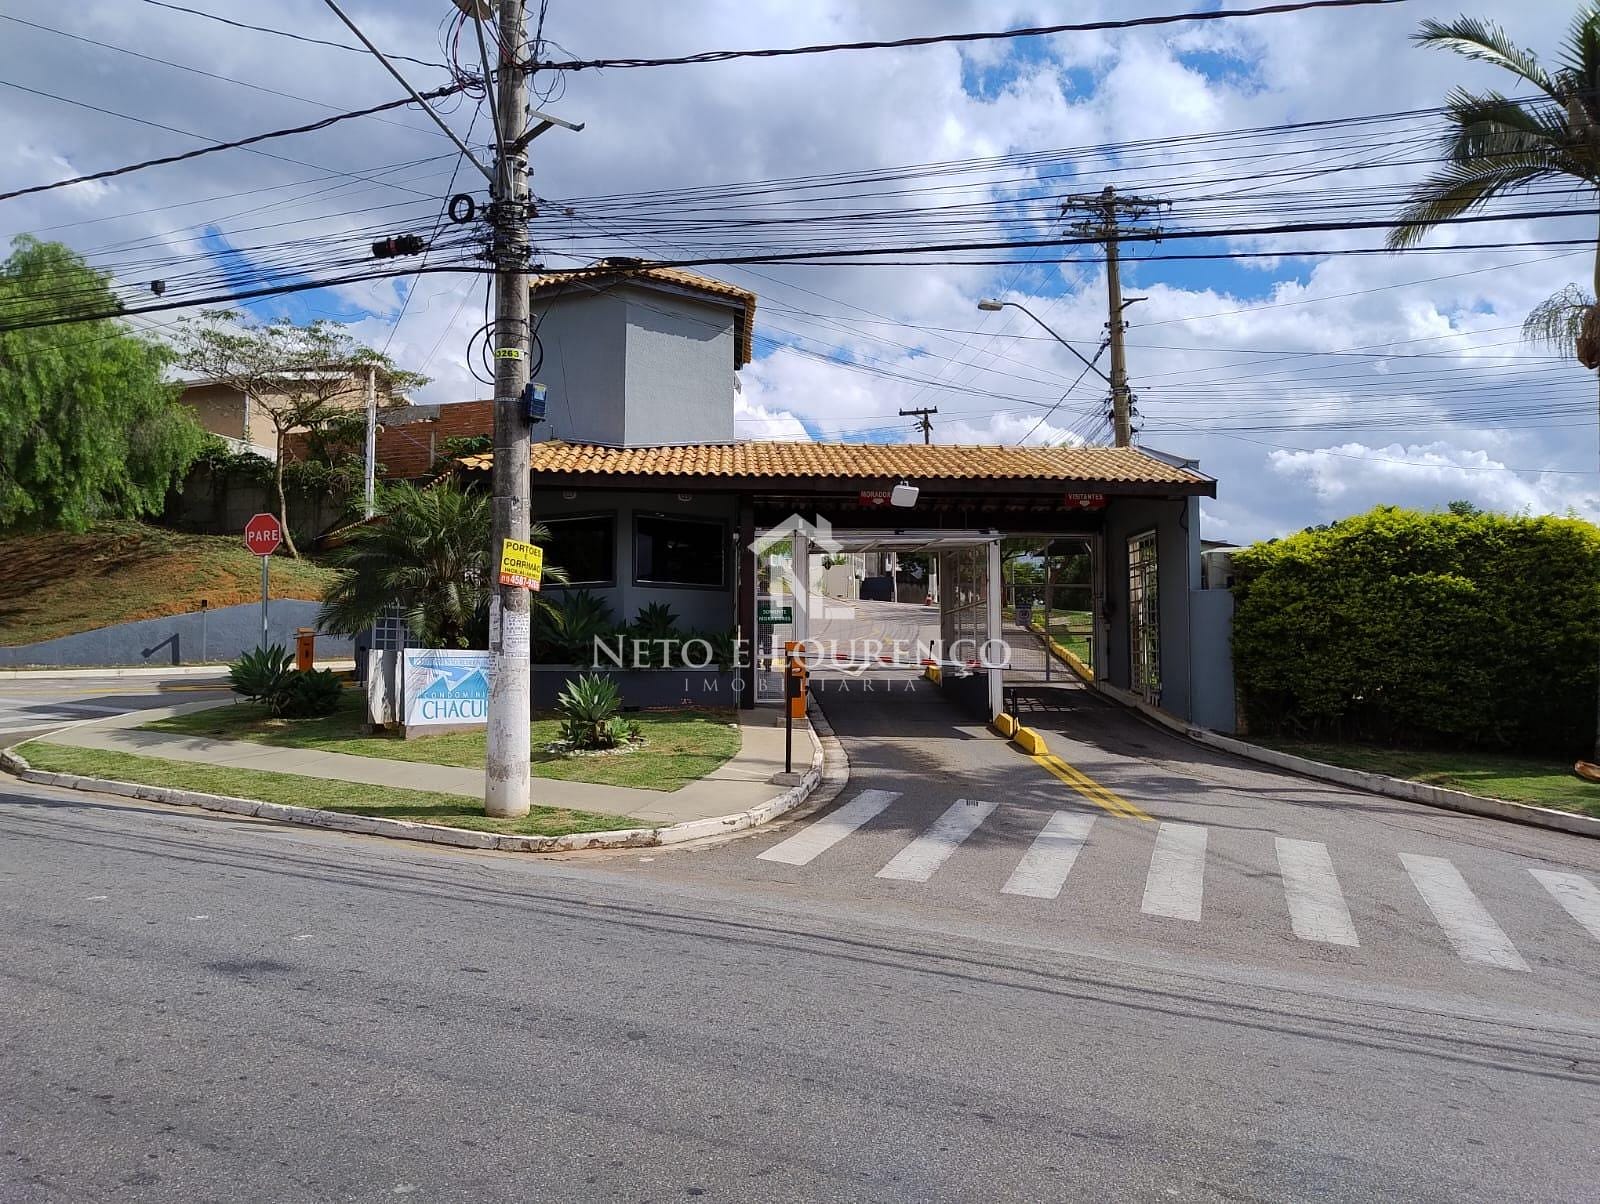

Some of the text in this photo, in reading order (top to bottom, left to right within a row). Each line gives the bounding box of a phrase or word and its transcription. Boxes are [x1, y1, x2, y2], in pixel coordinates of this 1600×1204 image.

[860, 490, 891, 498] MORADOR
[248, 529, 279, 541] PARE
[424, 691, 489, 699] CONDOMINI
[422, 700, 489, 719] CHACU
